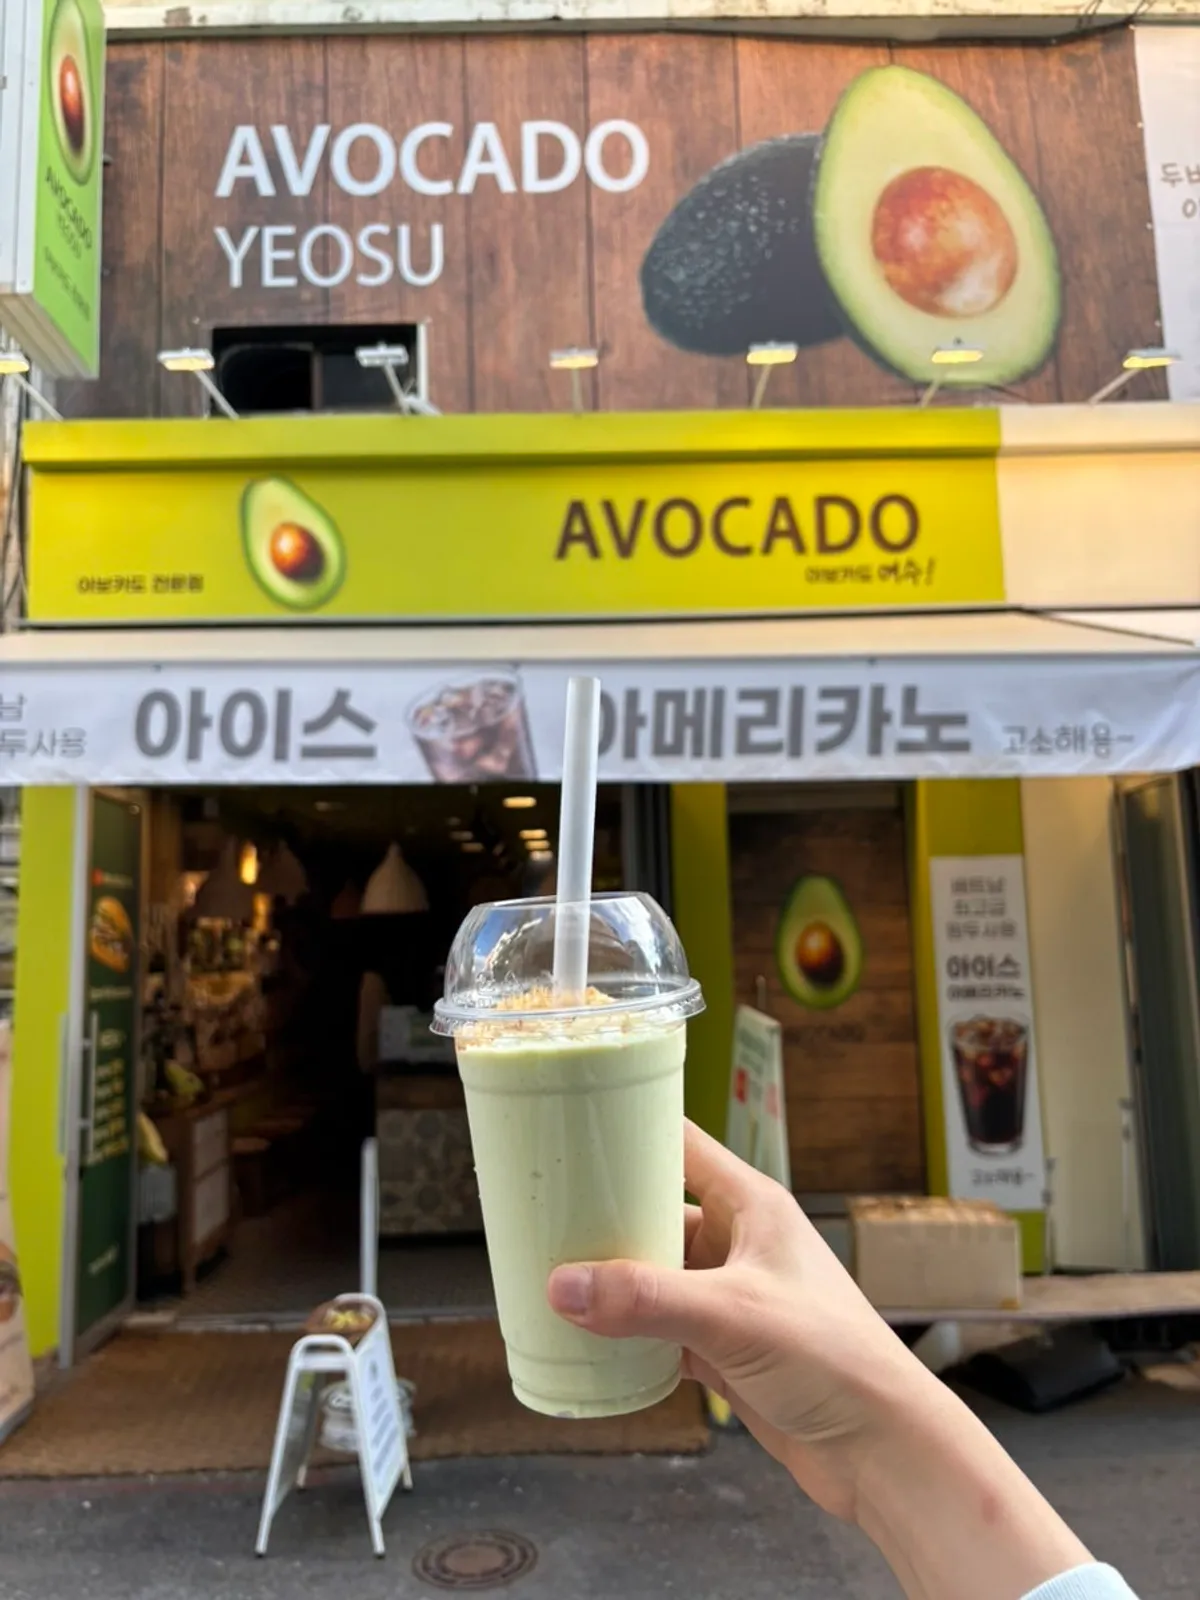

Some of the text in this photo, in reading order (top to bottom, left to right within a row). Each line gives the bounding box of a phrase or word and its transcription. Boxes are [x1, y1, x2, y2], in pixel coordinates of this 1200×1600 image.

[215, 119, 650, 197] AVOCADO
[215, 223, 444, 288] YEOSU
[555, 494, 920, 560] AVOCADO
[77, 575, 147, 594] 아보카도
[135, 685, 971, 762] 아이스 아메리카노
[946, 954, 1021, 979] 아이스
